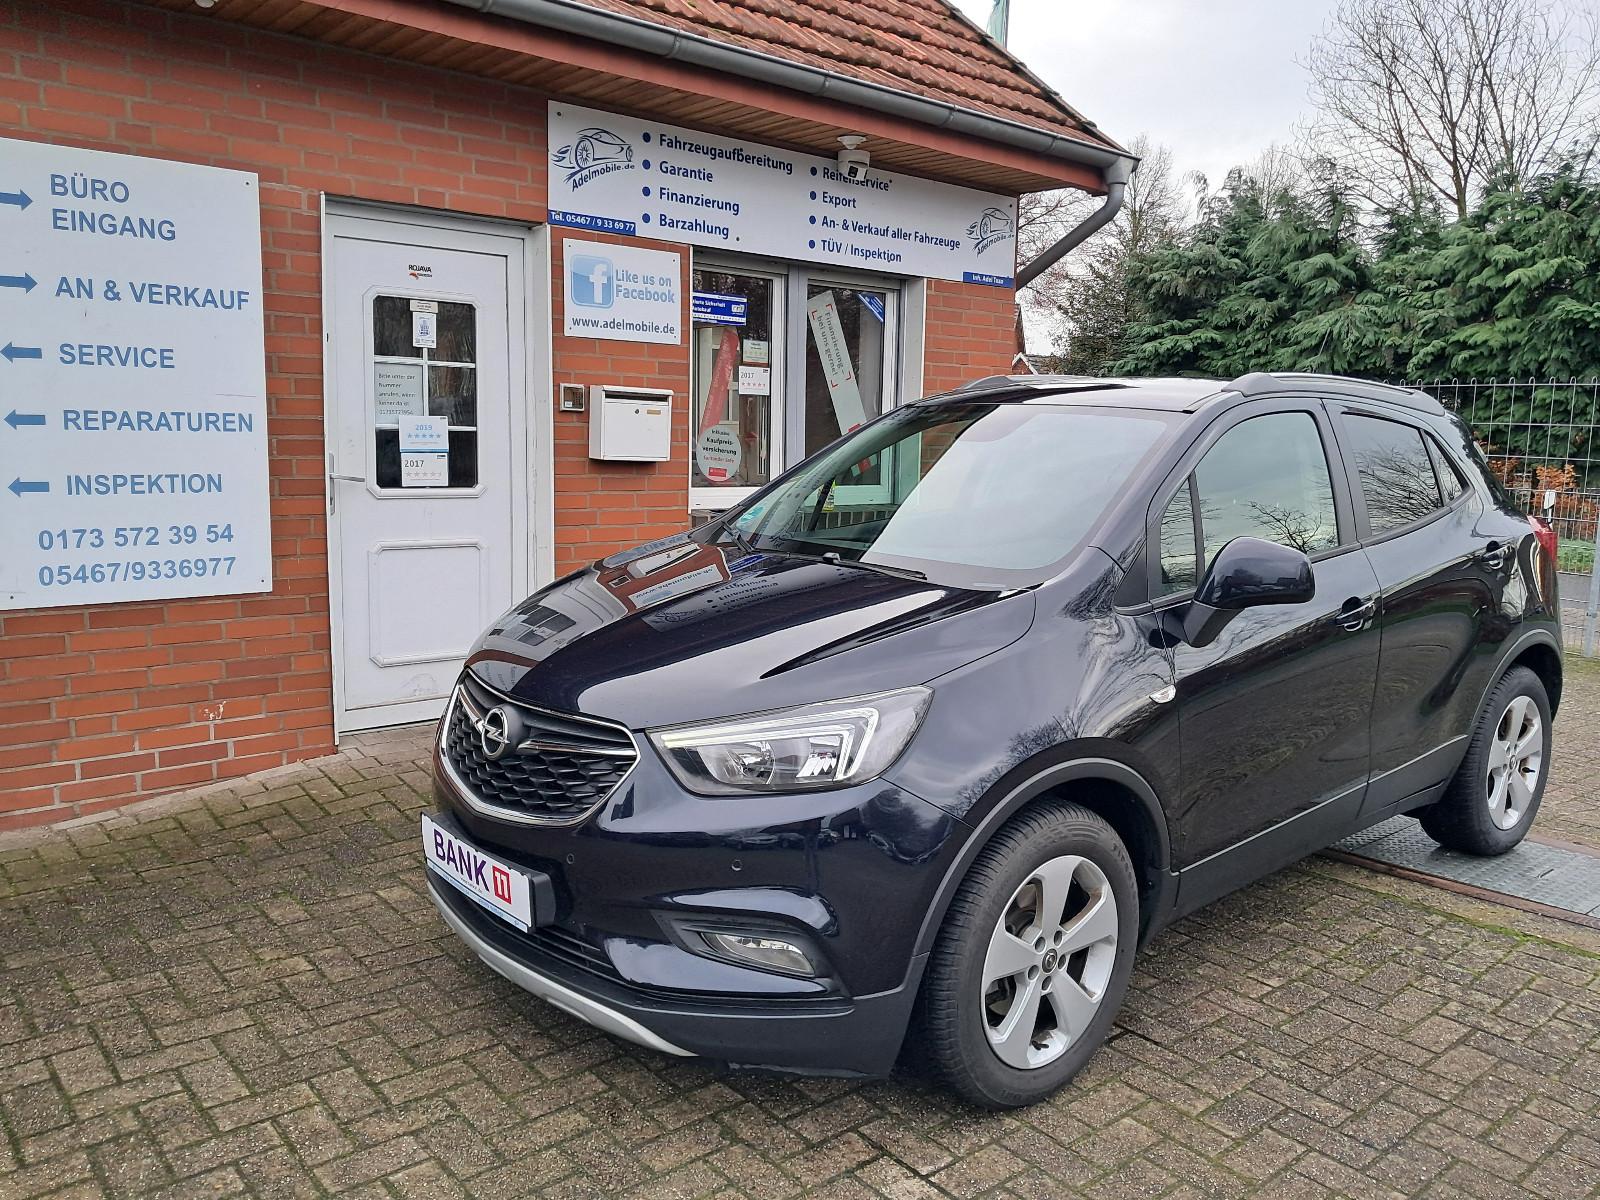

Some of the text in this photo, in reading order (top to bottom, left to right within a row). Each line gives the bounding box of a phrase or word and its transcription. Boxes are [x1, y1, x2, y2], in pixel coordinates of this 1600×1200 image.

[659, 134, 793, 175] Fahrzeugaufbereitung
[572, 164, 635, 192] Adelmobile.de
[659, 161, 713, 182] Garantie
[50, 172, 130, 203] BÜRO
[659, 187, 740, 215] Finanzierung
[822, 191, 857, 208] Export
[52, 208, 176, 241] EINGANG
[550, 212, 564, 222] Tel.
[566, 214, 591, 225] 05467
[603, 220, 613, 228] 33
[614, 221, 624, 230] 69
[625, 223, 635, 231] 77
[659, 214, 729, 239] Barzahlung
[822, 216, 961, 251] An- & Verkauf aller Fahrzeuge
[821, 238, 843, 254] TÜV
[850, 243, 902, 263] Inspektion
[615, 269, 672, 287] Like us on
[55, 276, 250, 310] AN & VERKAUF
[615, 284, 675, 304] Facebook
[572, 317, 675, 335] www.adelmobile.de
[817, 315, 825, 329] bei
[821, 331, 829, 346] uns
[825, 312, 843, 369] Finanzierung
[59, 343, 175, 369] SERVICE
[63, 409, 253, 433] REPARATUREN
[404, 459, 425, 468] 2017
[66, 473, 223, 496] INSPEKTION
[38, 523, 234, 551] 0173 572 39 54
[38, 556, 236, 587] 05467/9336977
[434, 828, 490, 892] BANK
